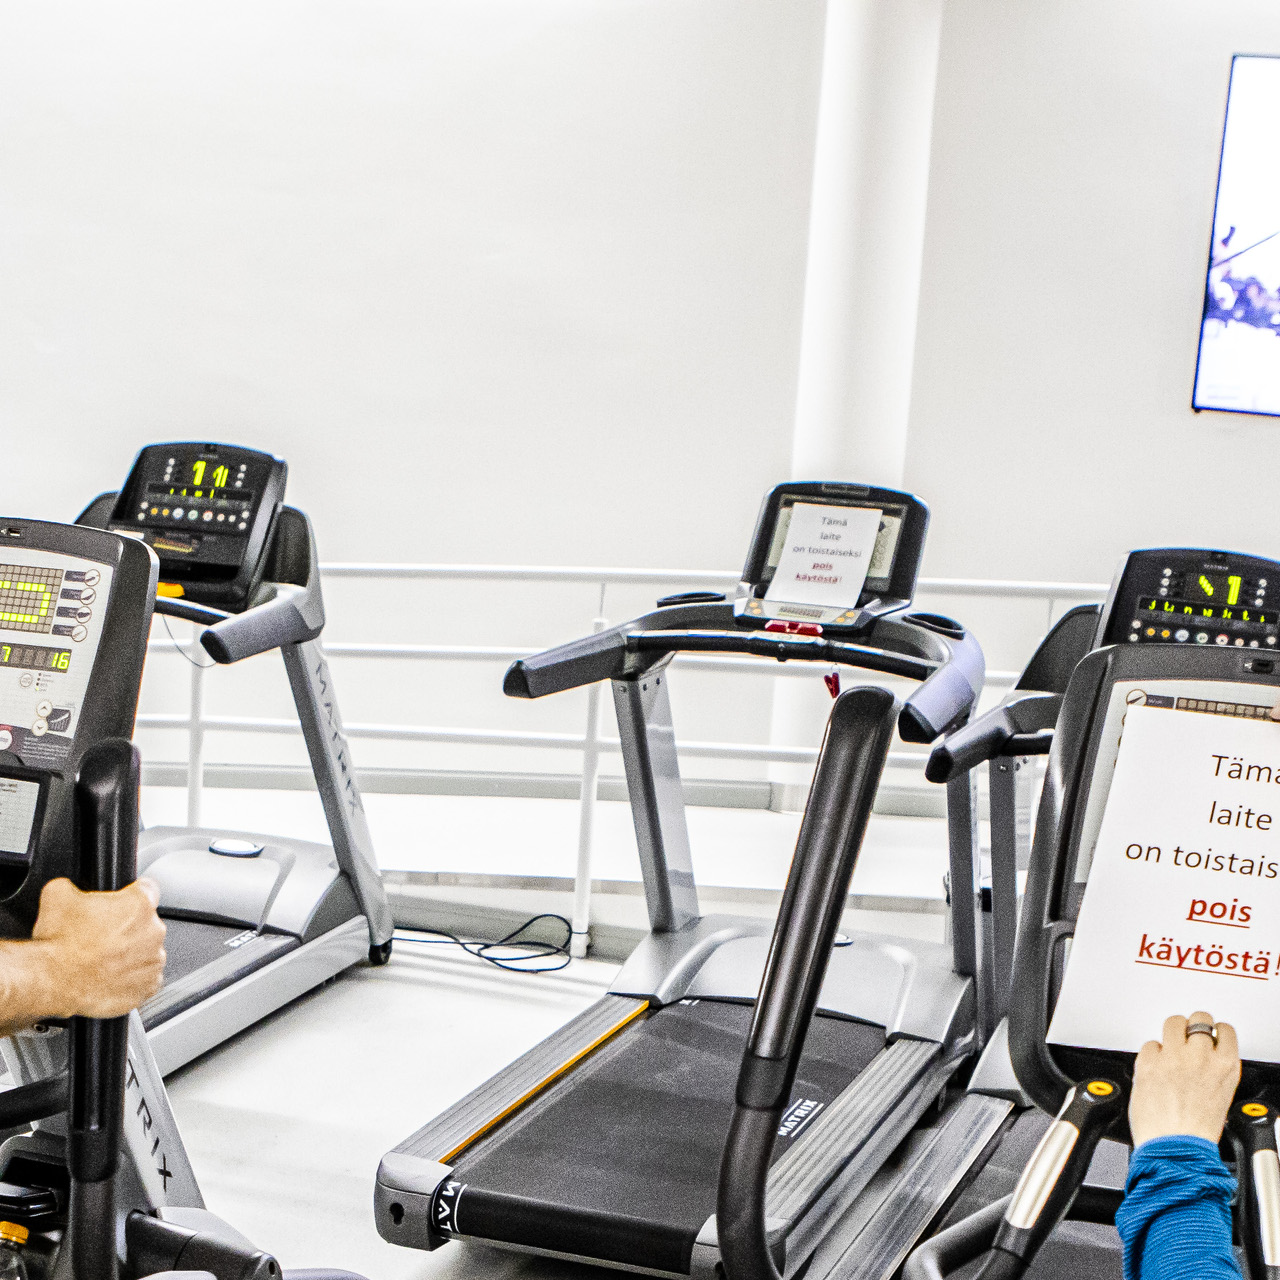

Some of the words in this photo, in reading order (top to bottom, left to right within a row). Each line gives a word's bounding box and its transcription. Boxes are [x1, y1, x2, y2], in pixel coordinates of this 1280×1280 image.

[821, 516, 848, 527] Tämä
[820, 532, 842, 541] laite
[808, 546, 862, 558] toistaiseksi
[811, 562, 833, 571] pois
[51, 651, 71, 670] 16
[1209, 801, 1273, 831] laite
[1125, 843, 1162, 864] on
[1187, 898, 1253, 926] pois
[777, 1099, 818, 1136] MATRIX
